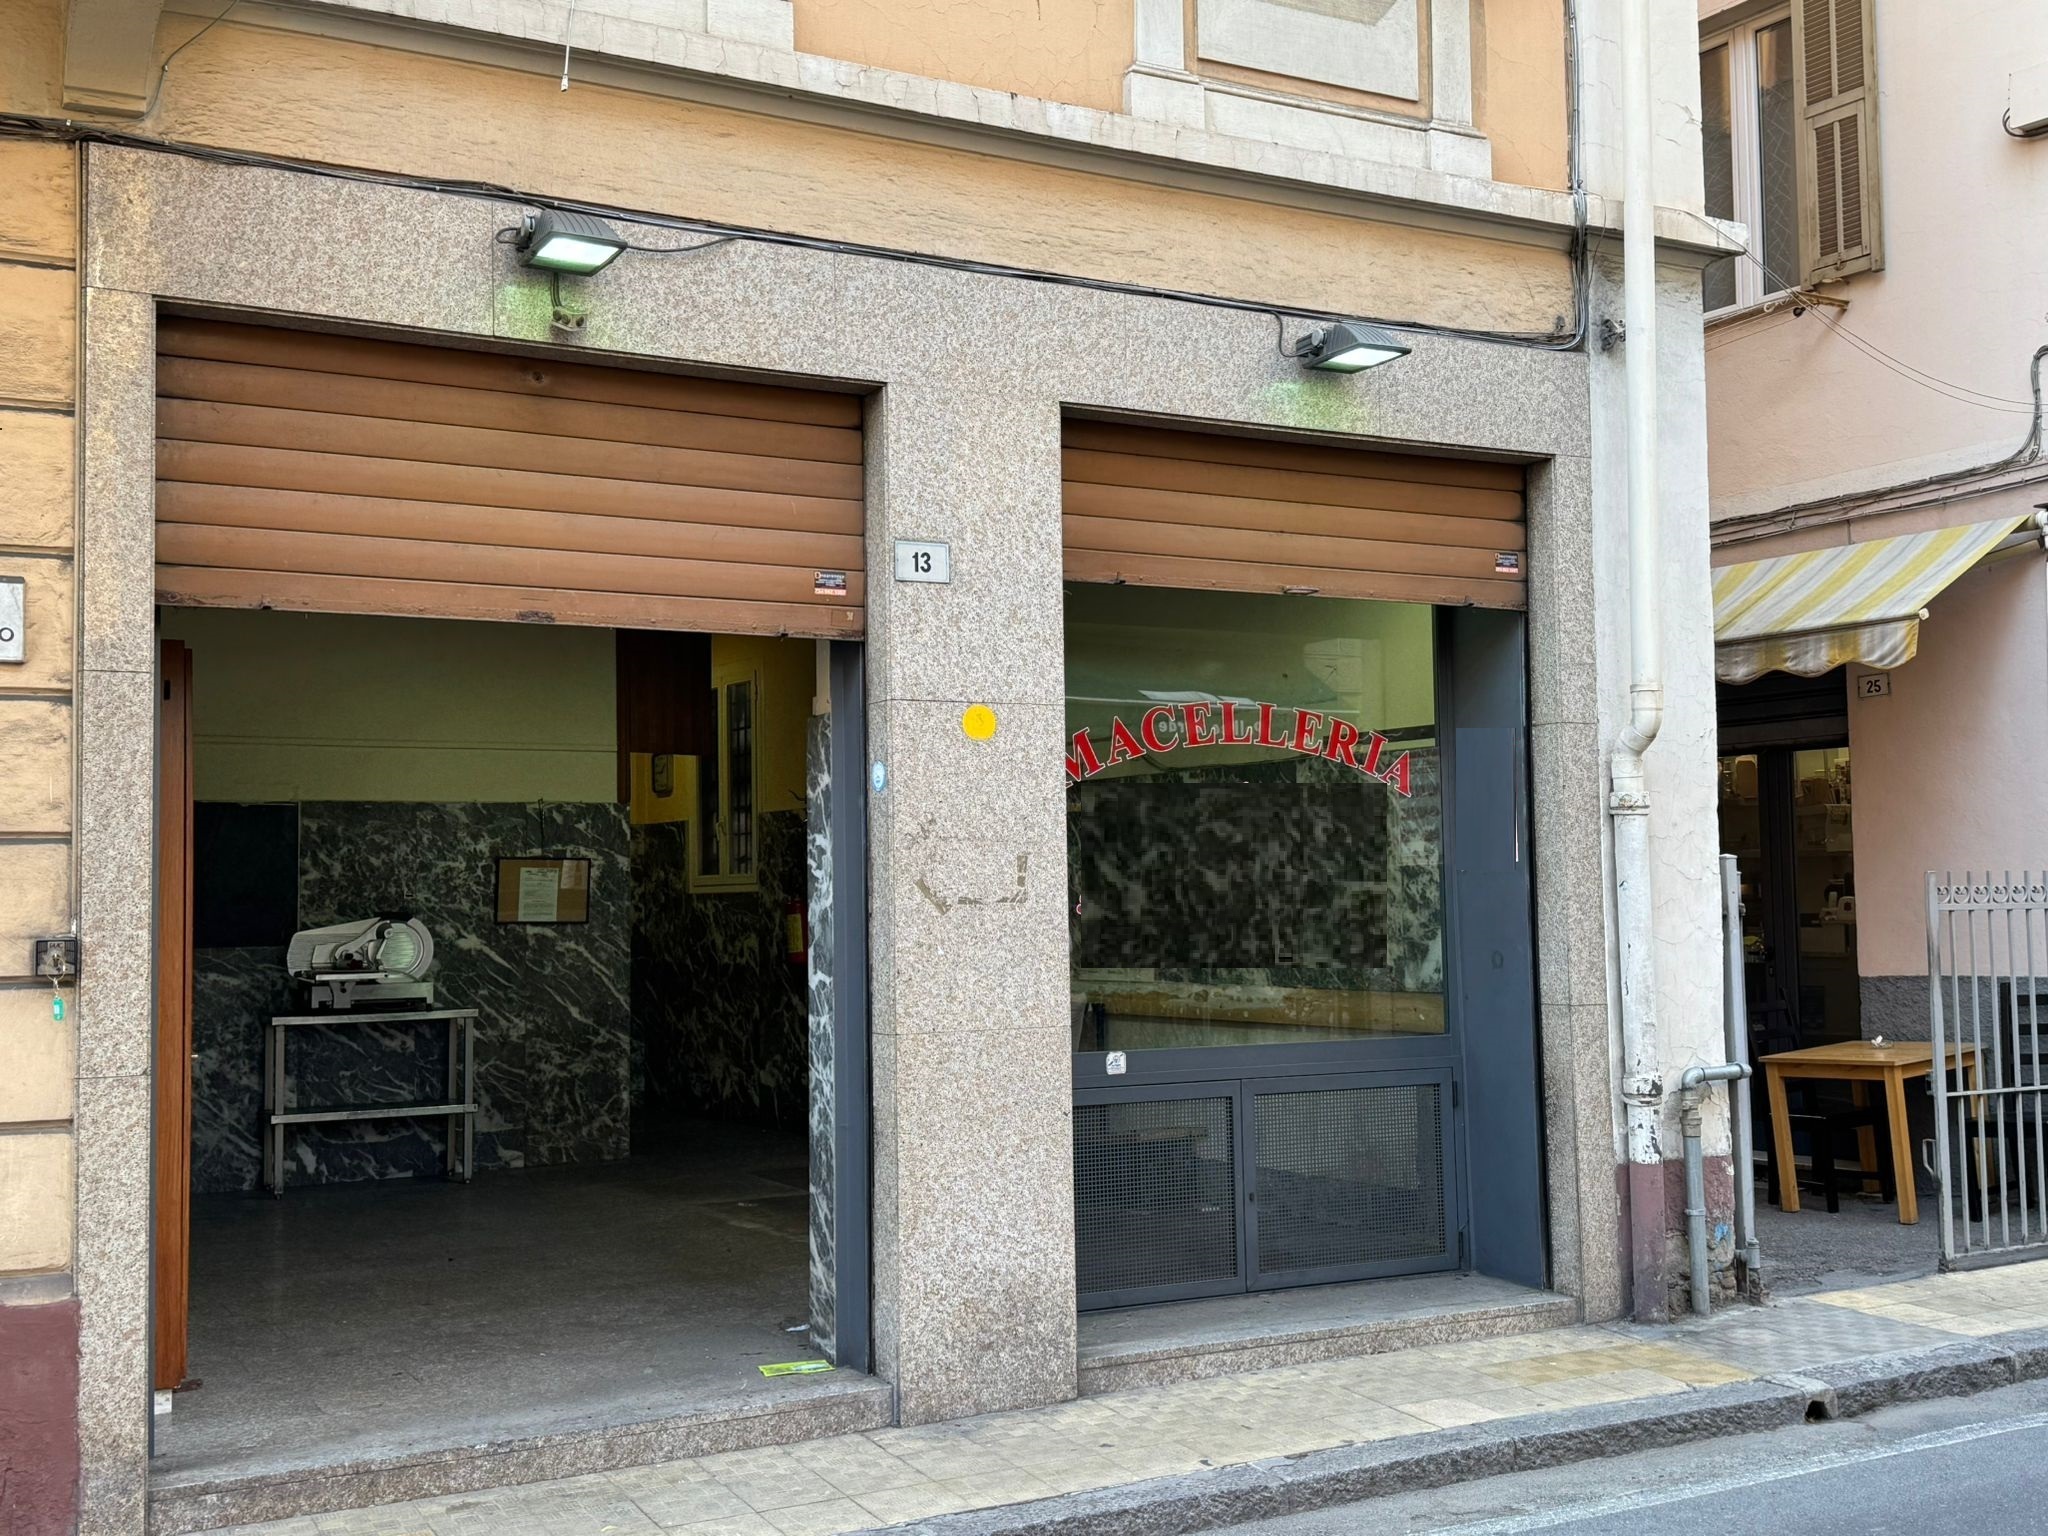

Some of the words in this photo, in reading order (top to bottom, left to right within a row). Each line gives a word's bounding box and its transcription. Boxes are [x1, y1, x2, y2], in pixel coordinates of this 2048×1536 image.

[912, 551, 931, 573] 13
[1866, 679, 1882, 693] 25
[1065, 701, 1412, 798] MACELLERIA
